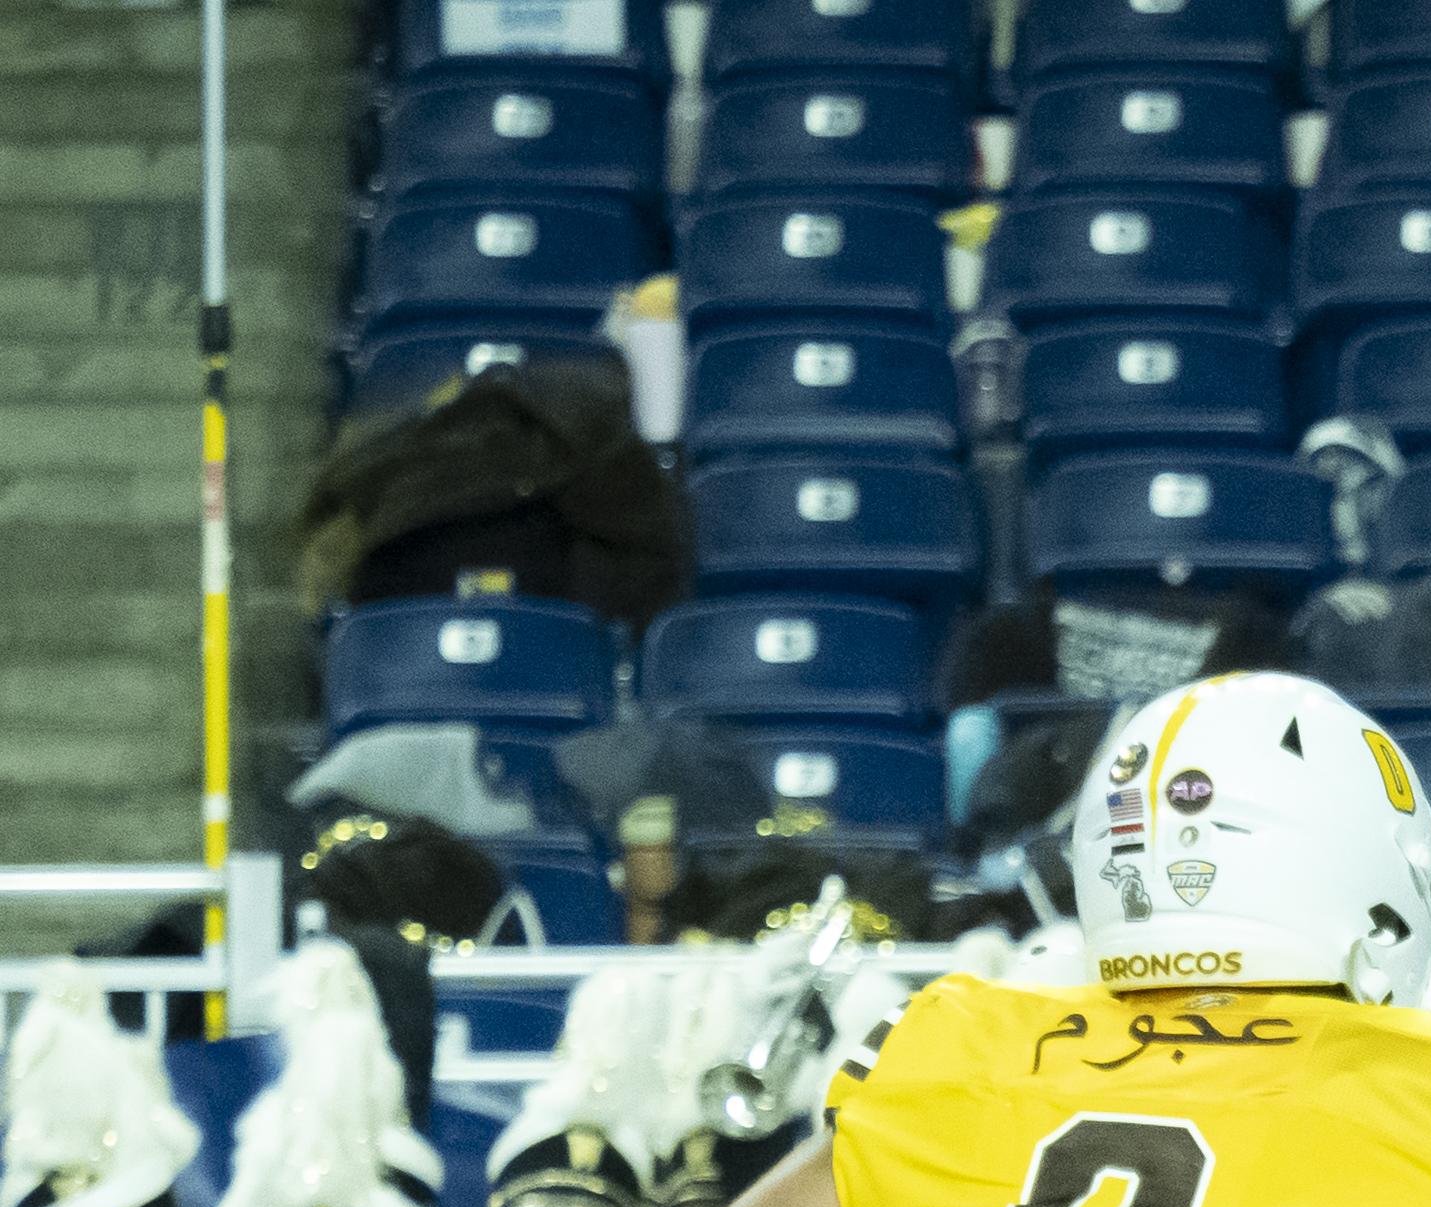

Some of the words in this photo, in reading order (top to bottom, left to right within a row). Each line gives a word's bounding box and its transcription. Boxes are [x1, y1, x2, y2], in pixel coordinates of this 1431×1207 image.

[1359, 728, 1417, 815] 0
[1099, 951, 1243, 982] BRONCOS
[1031, 1012, 1302, 1074] عجوم
